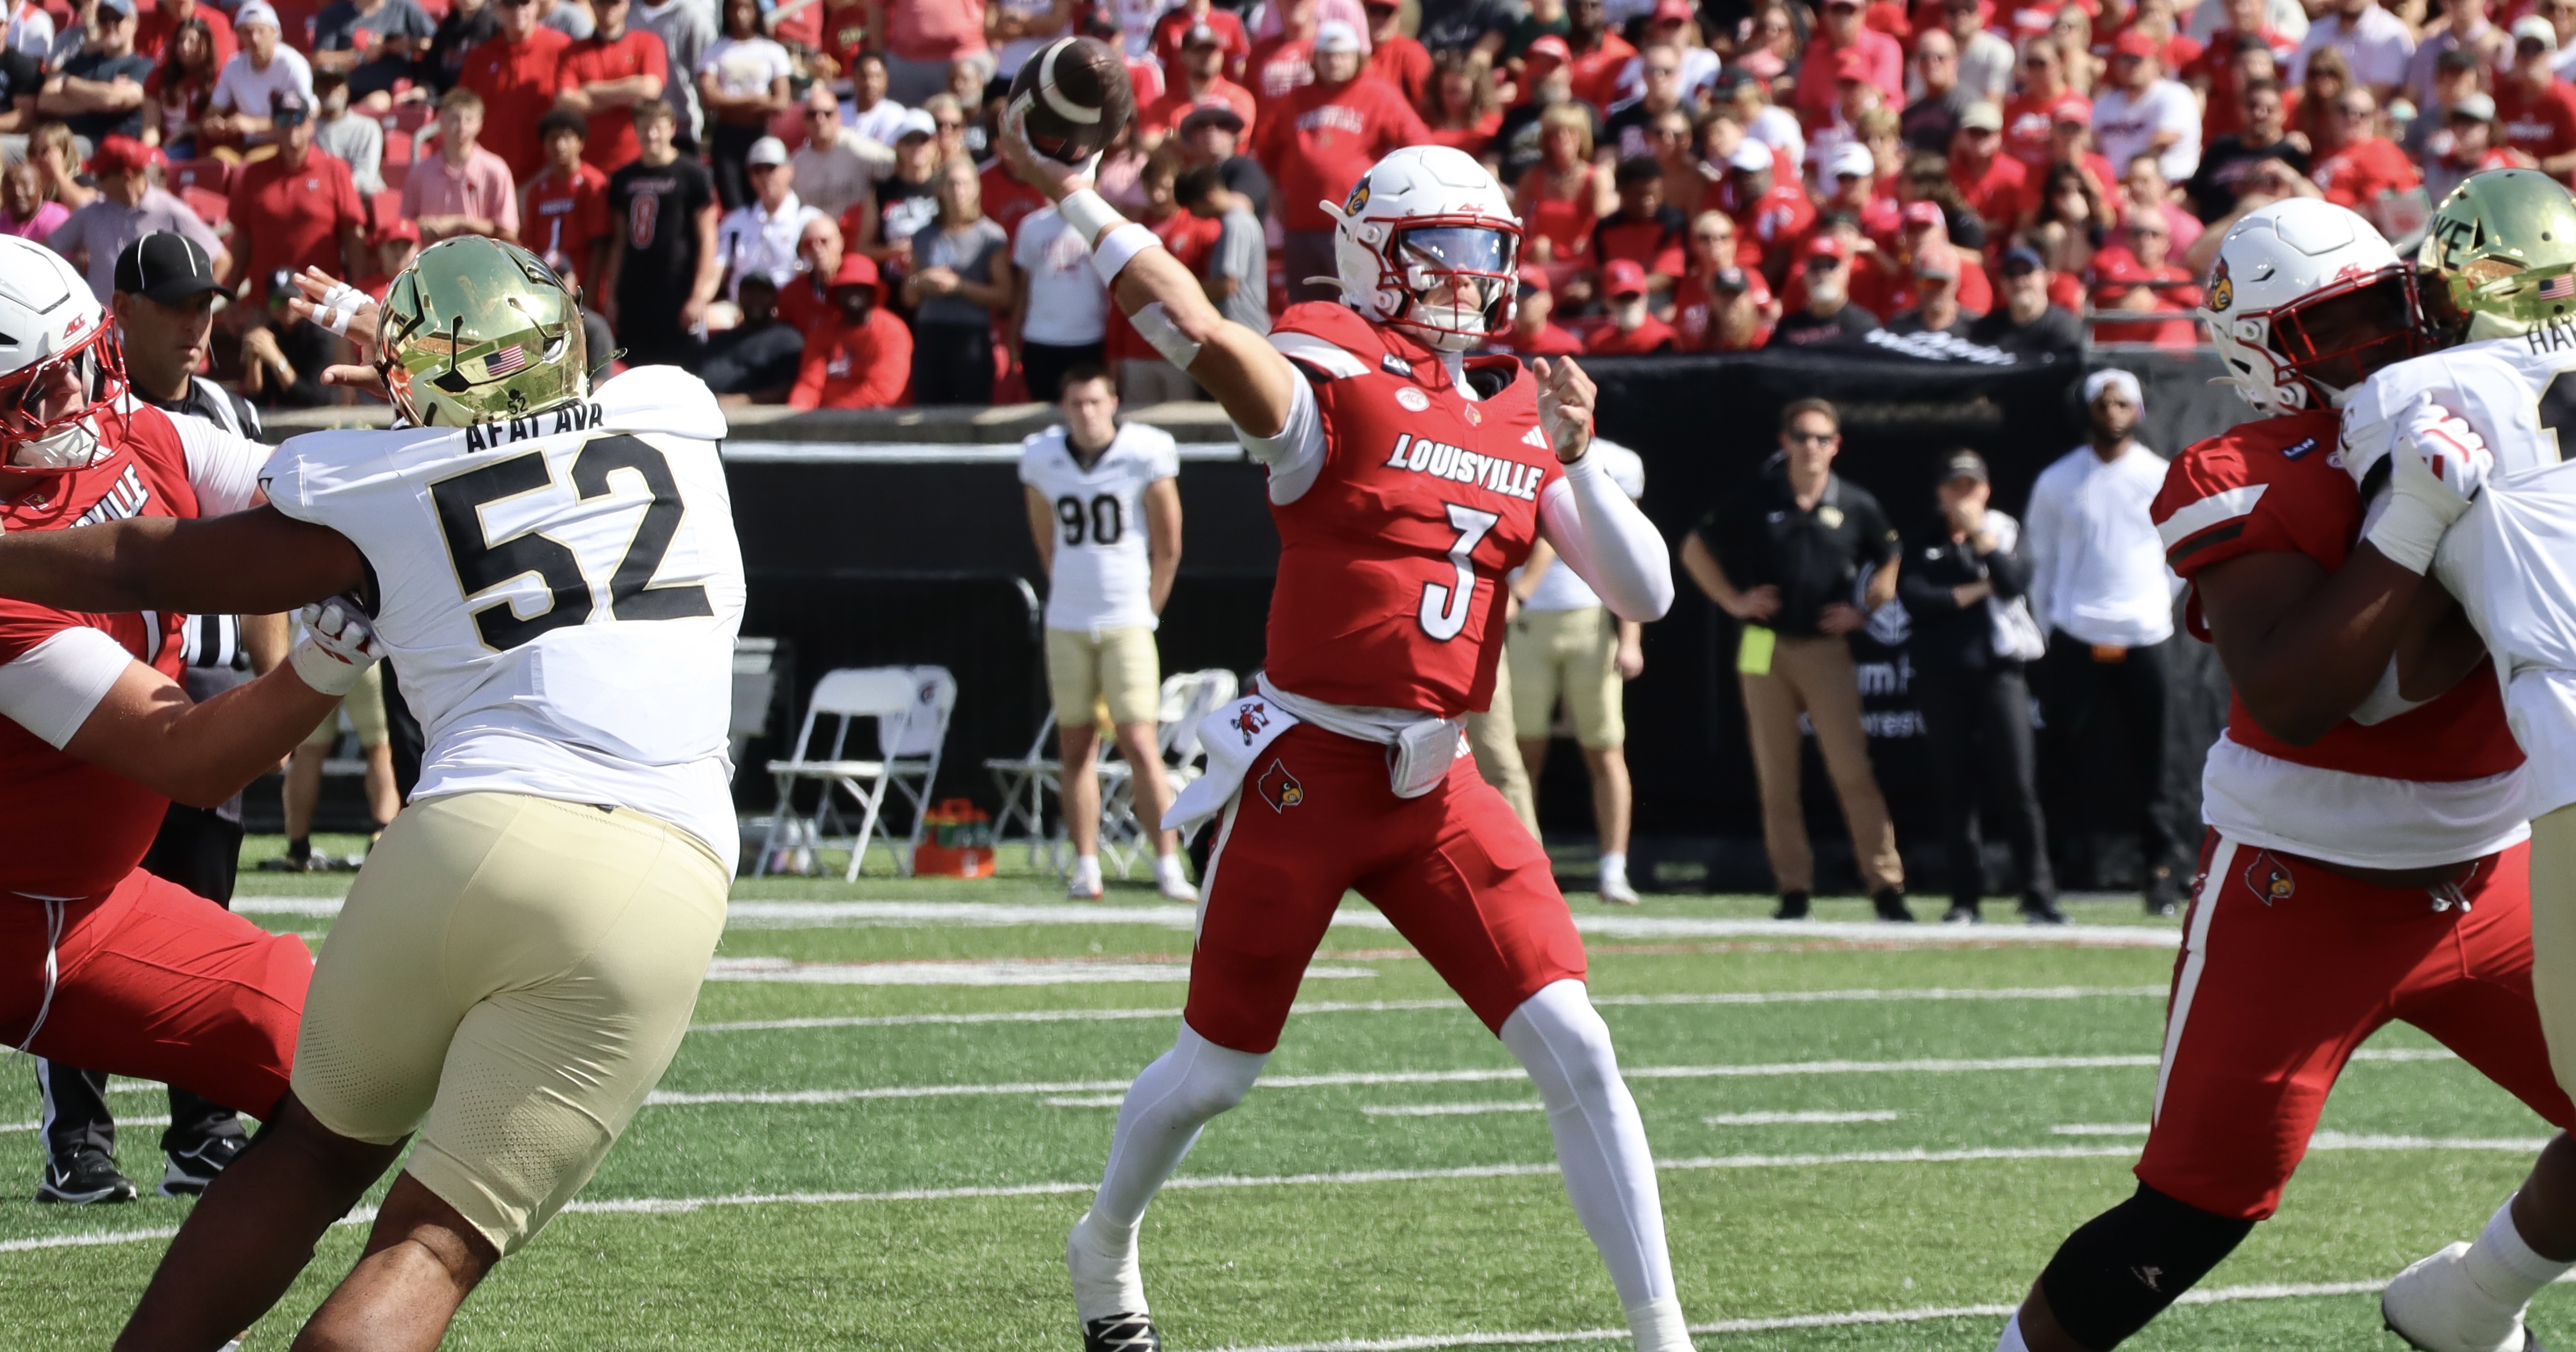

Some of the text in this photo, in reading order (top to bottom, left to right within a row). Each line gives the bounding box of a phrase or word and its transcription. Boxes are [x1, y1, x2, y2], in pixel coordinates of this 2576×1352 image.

[63, 312, 86, 340] ACC
[507, 397, 529, 414] 52
[1382, 432, 1546, 502] LOUISVILLE
[425, 432, 716, 654] 52
[1058, 494, 1121, 546] 90
[1418, 500, 1500, 642] 3
